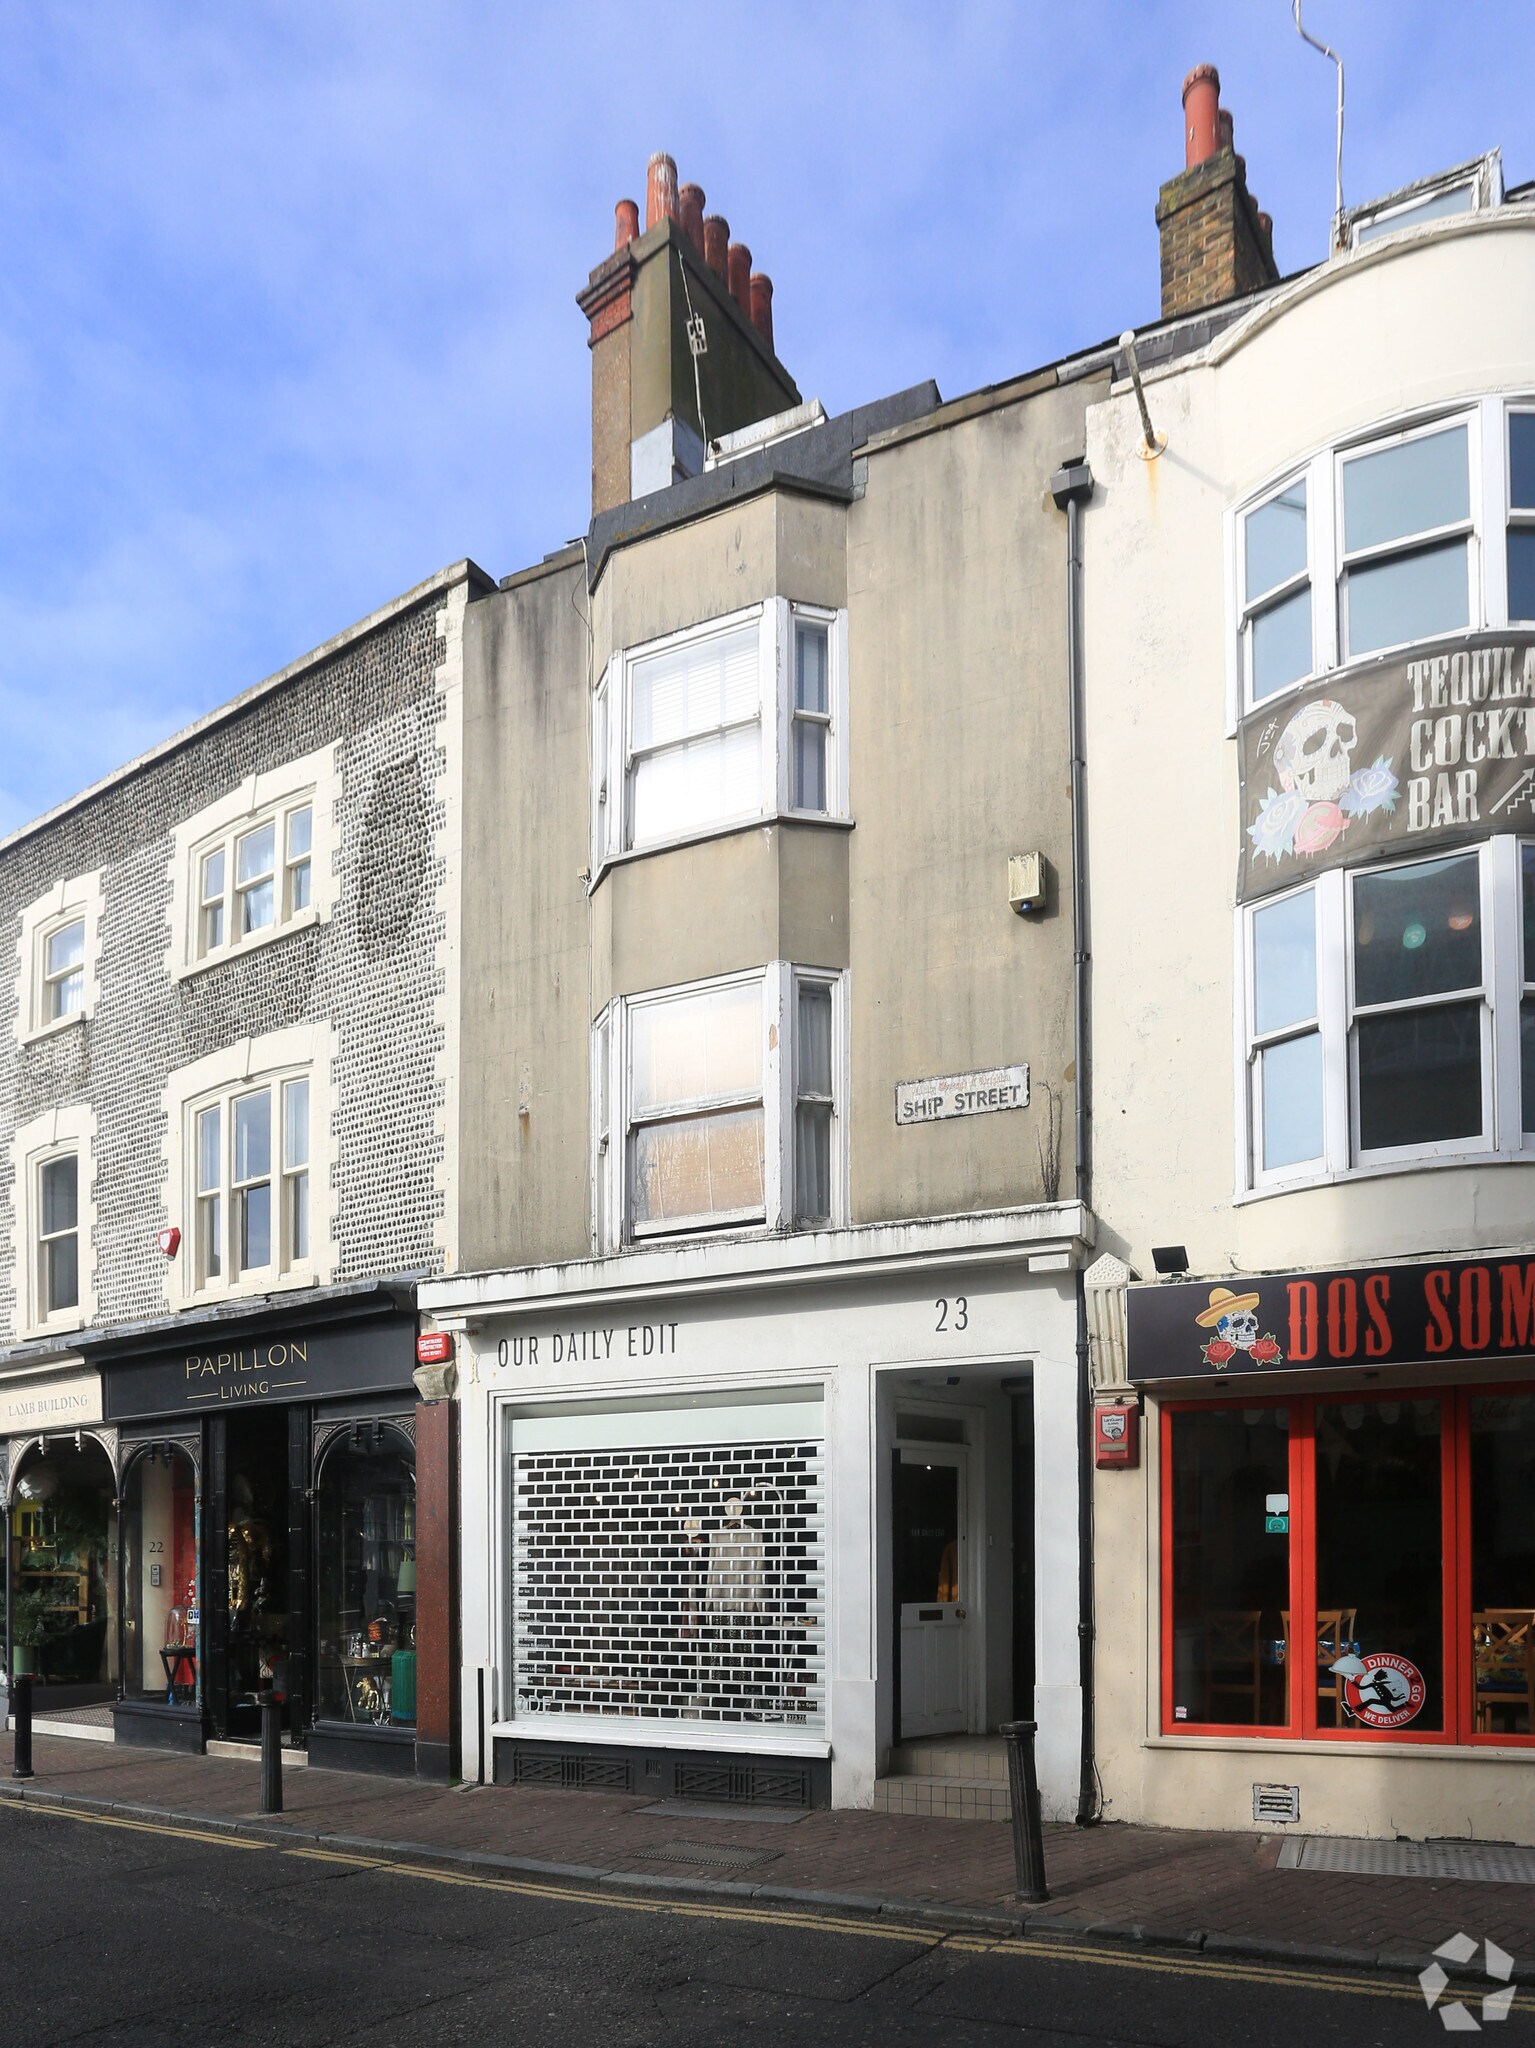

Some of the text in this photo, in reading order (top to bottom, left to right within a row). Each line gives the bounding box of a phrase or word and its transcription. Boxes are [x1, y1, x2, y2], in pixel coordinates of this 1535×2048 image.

[1406, 769, 1480, 832] BAR
[903, 1096, 943, 1118] SHIP
[955, 1085, 1021, 1110] STREET
[935, 1296, 969, 1332] 23
[1286, 1262, 1535, 1361] DOS SOM
[186, 1341, 307, 1379] PAPILLON
[498, 1322, 679, 1367] OUR DAILY EDIT
[8, 1394, 88, 1417] LAMB BUILDING
[221, 1381, 269, 1399] LIVING
[149, 1541, 164, 1553] 22
[1367, 1657, 1414, 1677] DINNER
[1411, 1685, 1422, 1702] GO
[1364, 1710, 1410, 1724] WE DELIVER
